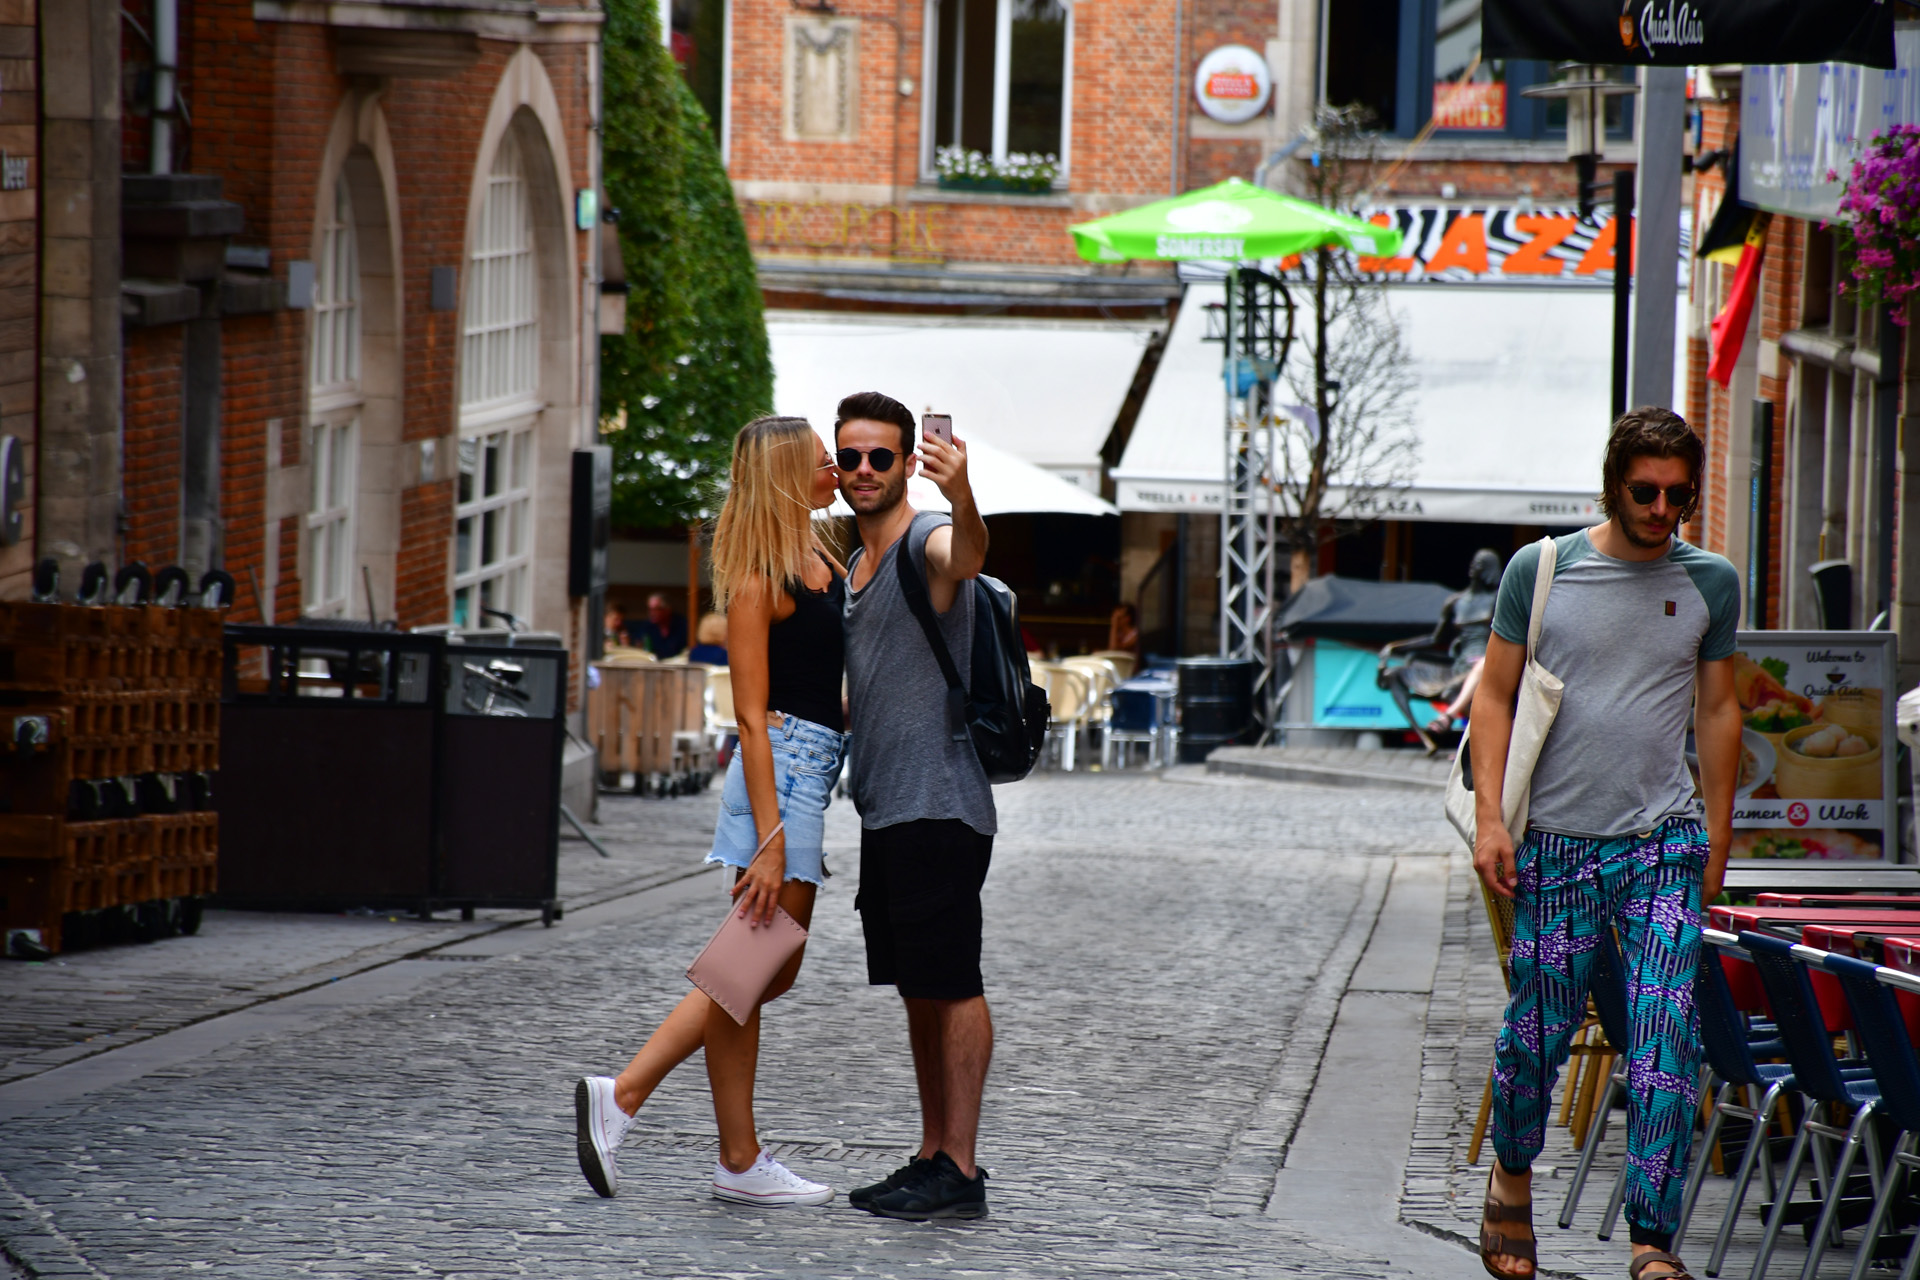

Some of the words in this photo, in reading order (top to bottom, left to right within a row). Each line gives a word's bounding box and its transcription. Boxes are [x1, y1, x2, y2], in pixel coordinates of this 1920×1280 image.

[752, 201, 946, 252] TROPOLE
[1156, 234, 1245, 258] SOMERSBY
[1279, 211, 1638, 276] LAZA
[1359, 499, 1424, 515] PLAZA
[1529, 503, 1579, 515] STELLA
[1806, 649, 1851, 663] Welcome
[1853, 650, 1866, 663] to
[1803, 684, 1834, 699] Quick
[1732, 808, 1786, 820] amen
[1790, 804, 1806, 820] &
[1818, 803, 1869, 820] Wok
